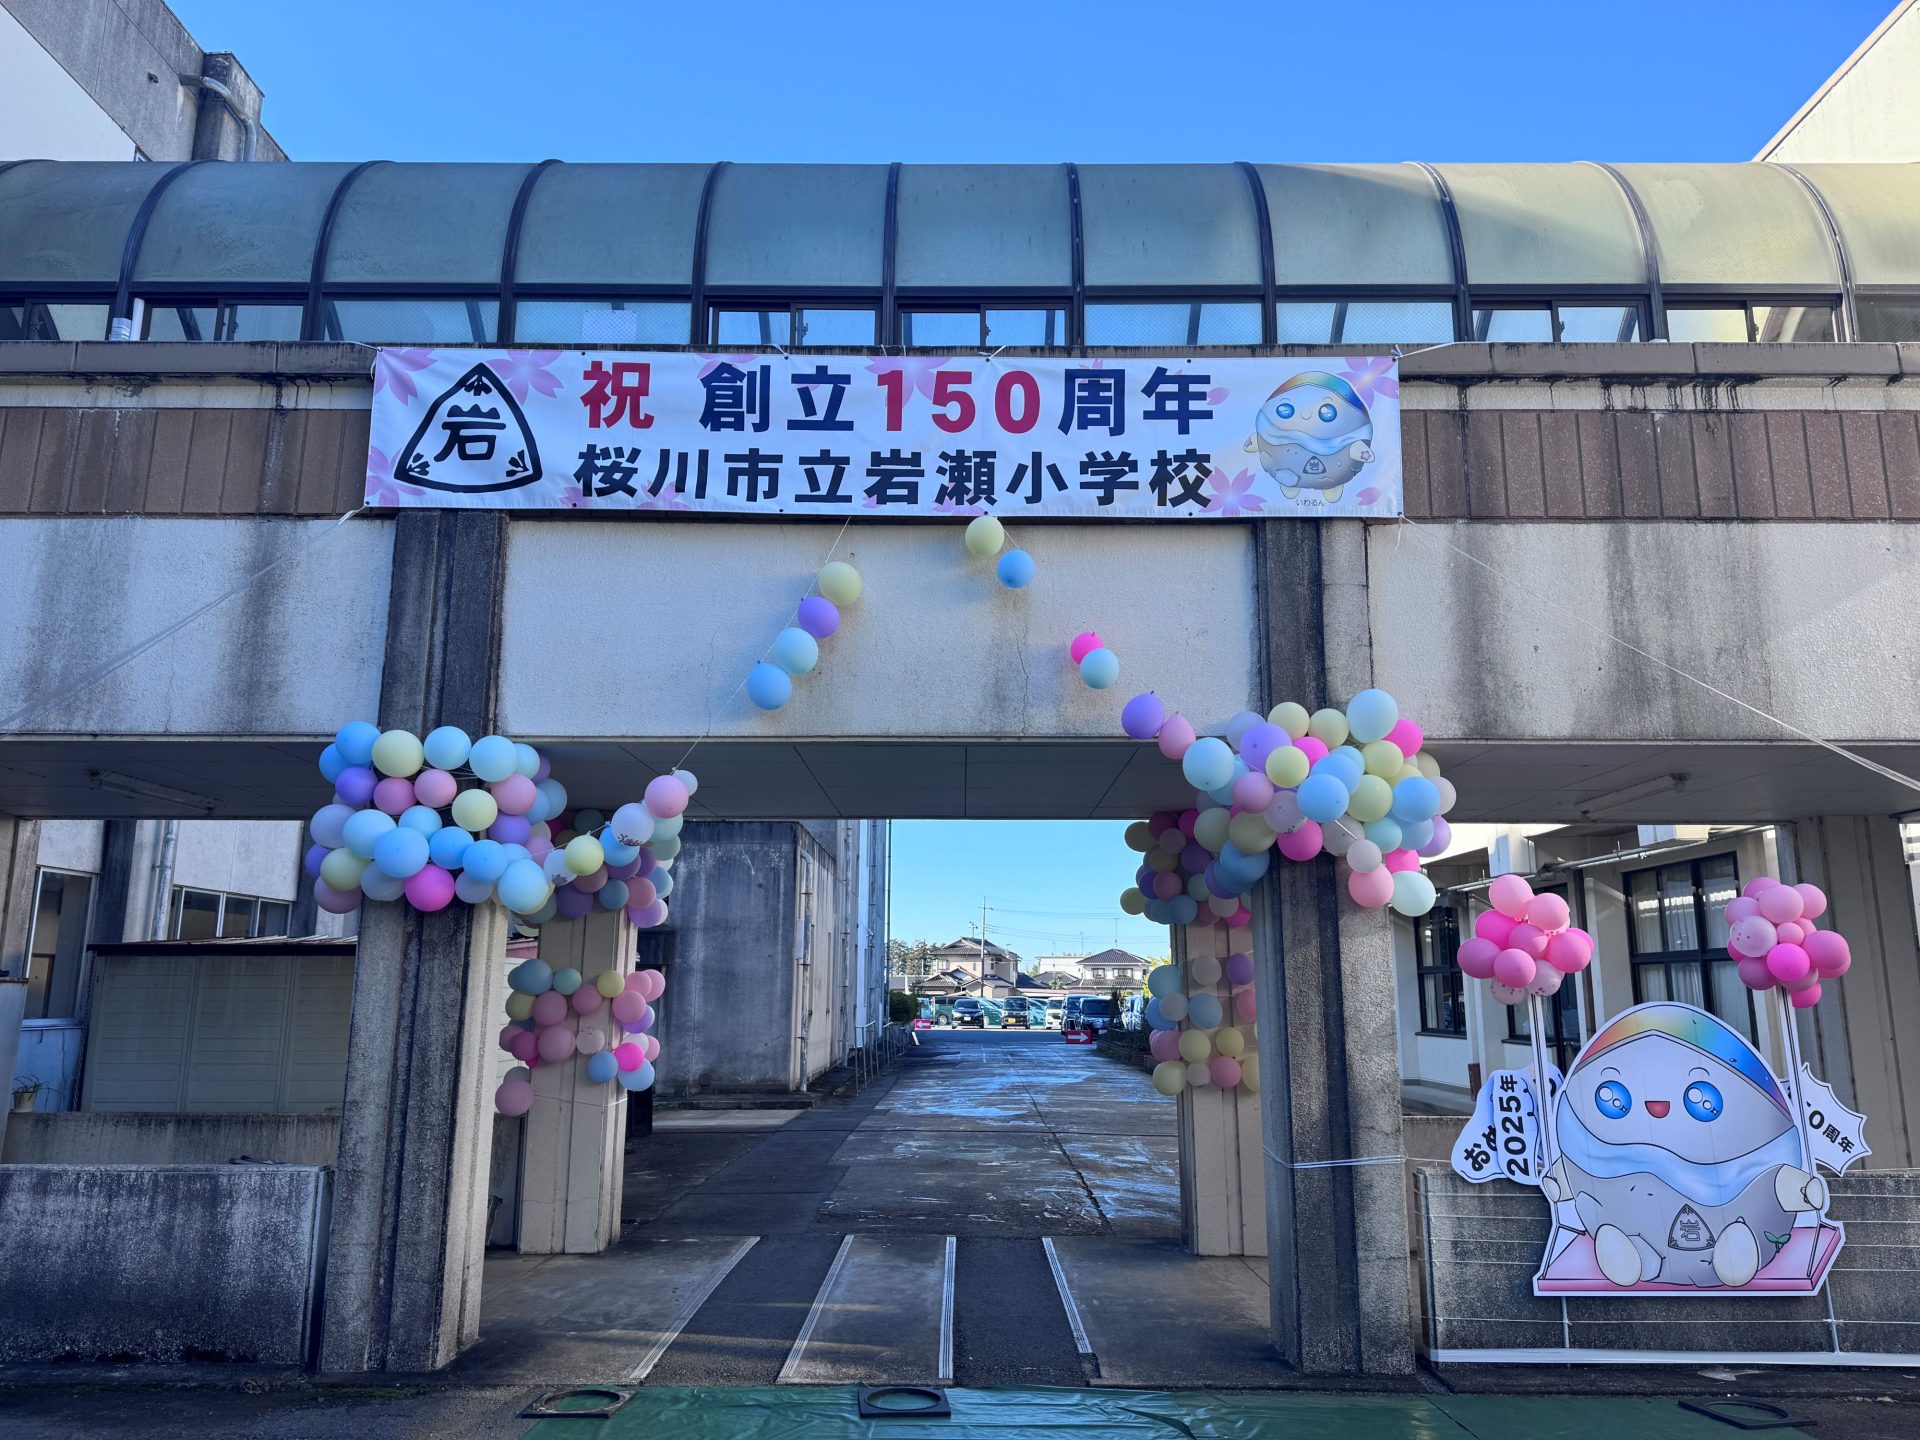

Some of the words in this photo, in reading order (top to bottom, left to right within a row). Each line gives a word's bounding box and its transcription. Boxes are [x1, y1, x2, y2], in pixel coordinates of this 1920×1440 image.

[580, 361, 655, 430] 祝
[699, 362, 1214, 437] 創立150周年
[573, 444, 1213, 508] 桜川市立岩瀬小学校
[1296, 499, 1325, 507] いわるん
[1498, 1074, 1530, 1177] 2025年
[1806, 1101, 1855, 1154] 0周年
